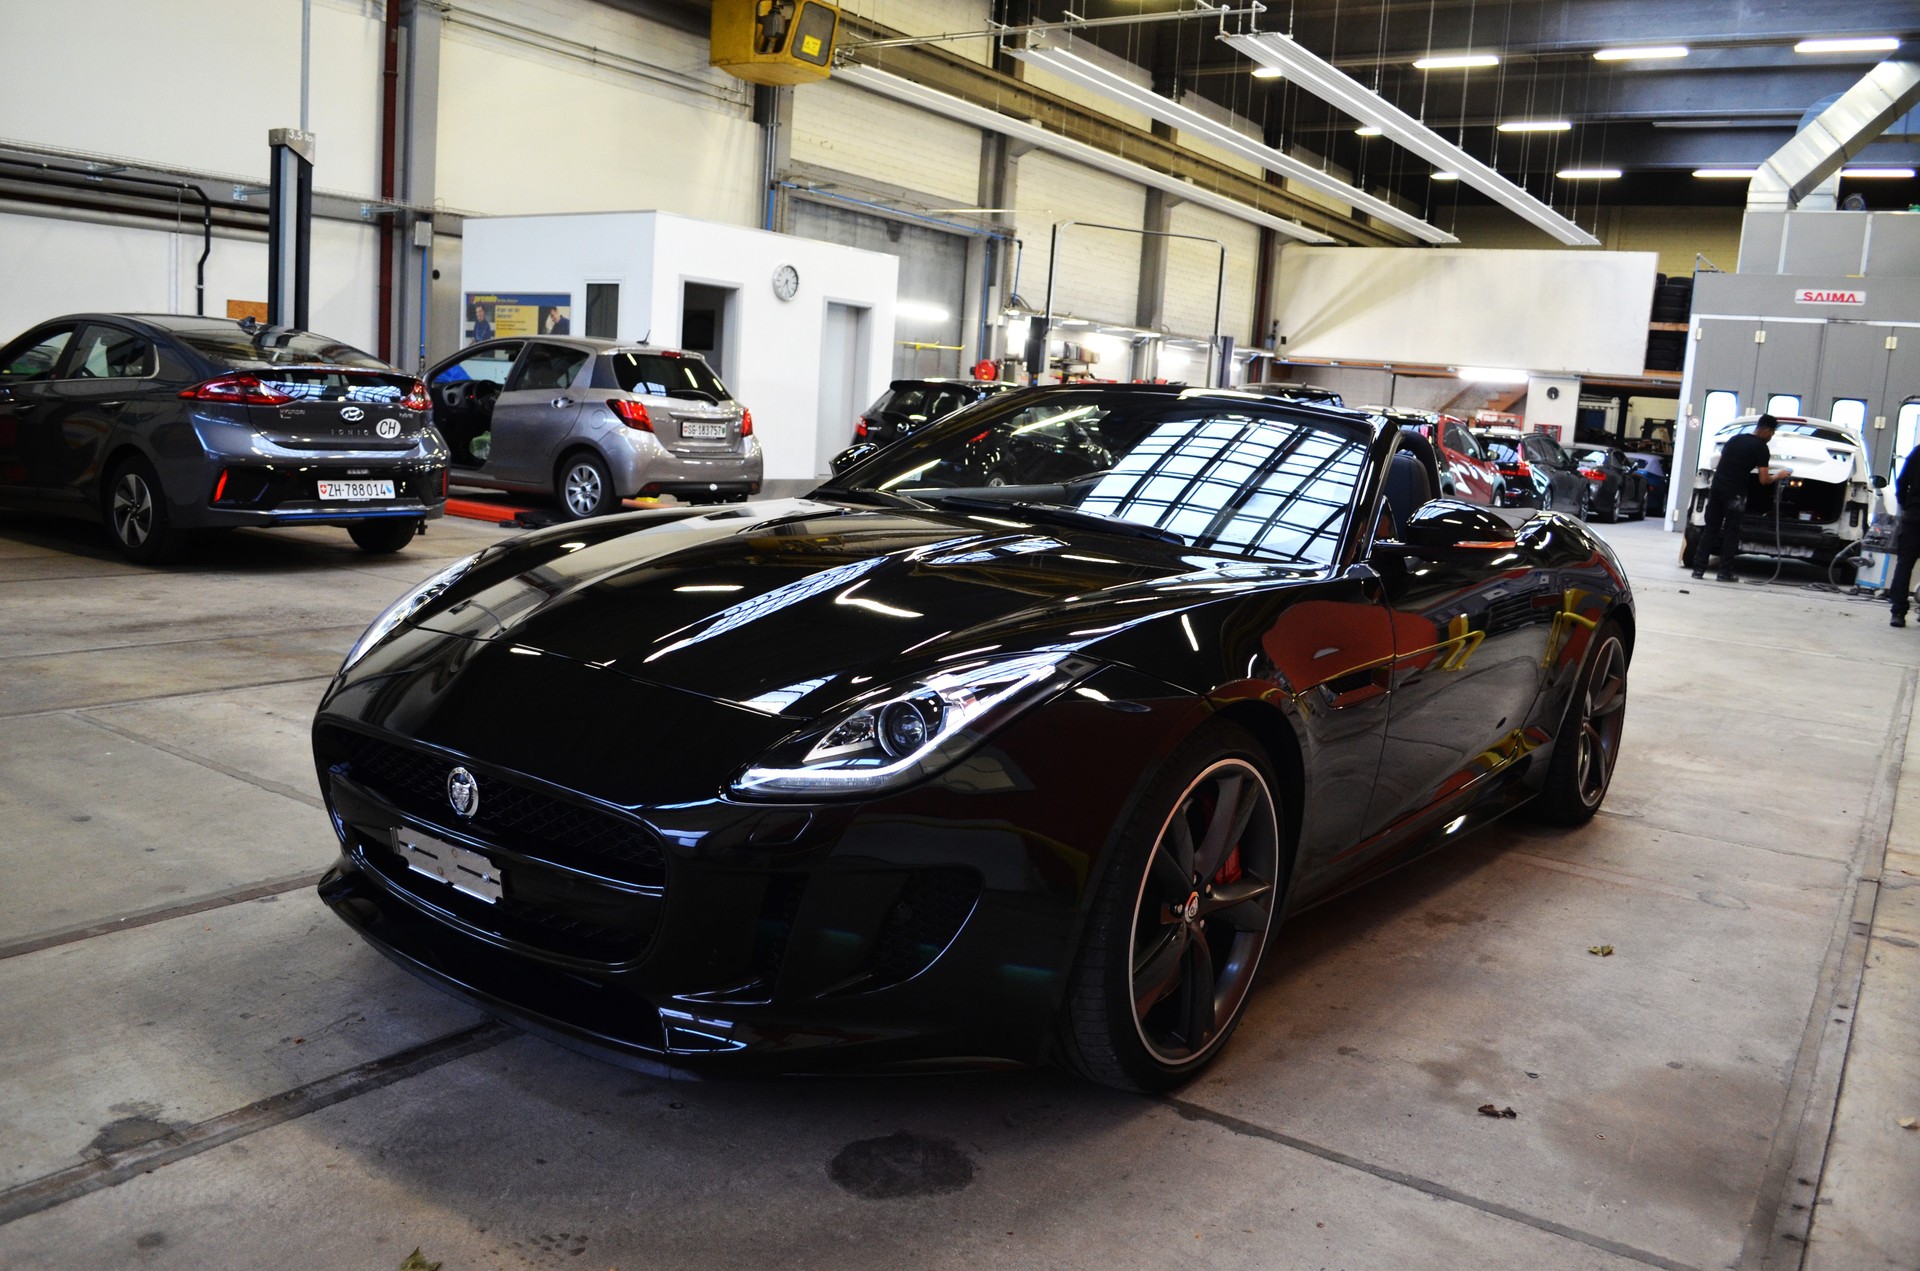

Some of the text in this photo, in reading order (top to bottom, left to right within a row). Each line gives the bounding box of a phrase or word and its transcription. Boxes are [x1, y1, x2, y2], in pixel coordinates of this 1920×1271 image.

[288, 129, 314, 142] 3,5 to
[1803, 291, 1857, 303] SAIMA
[379, 420, 397, 436] CH
